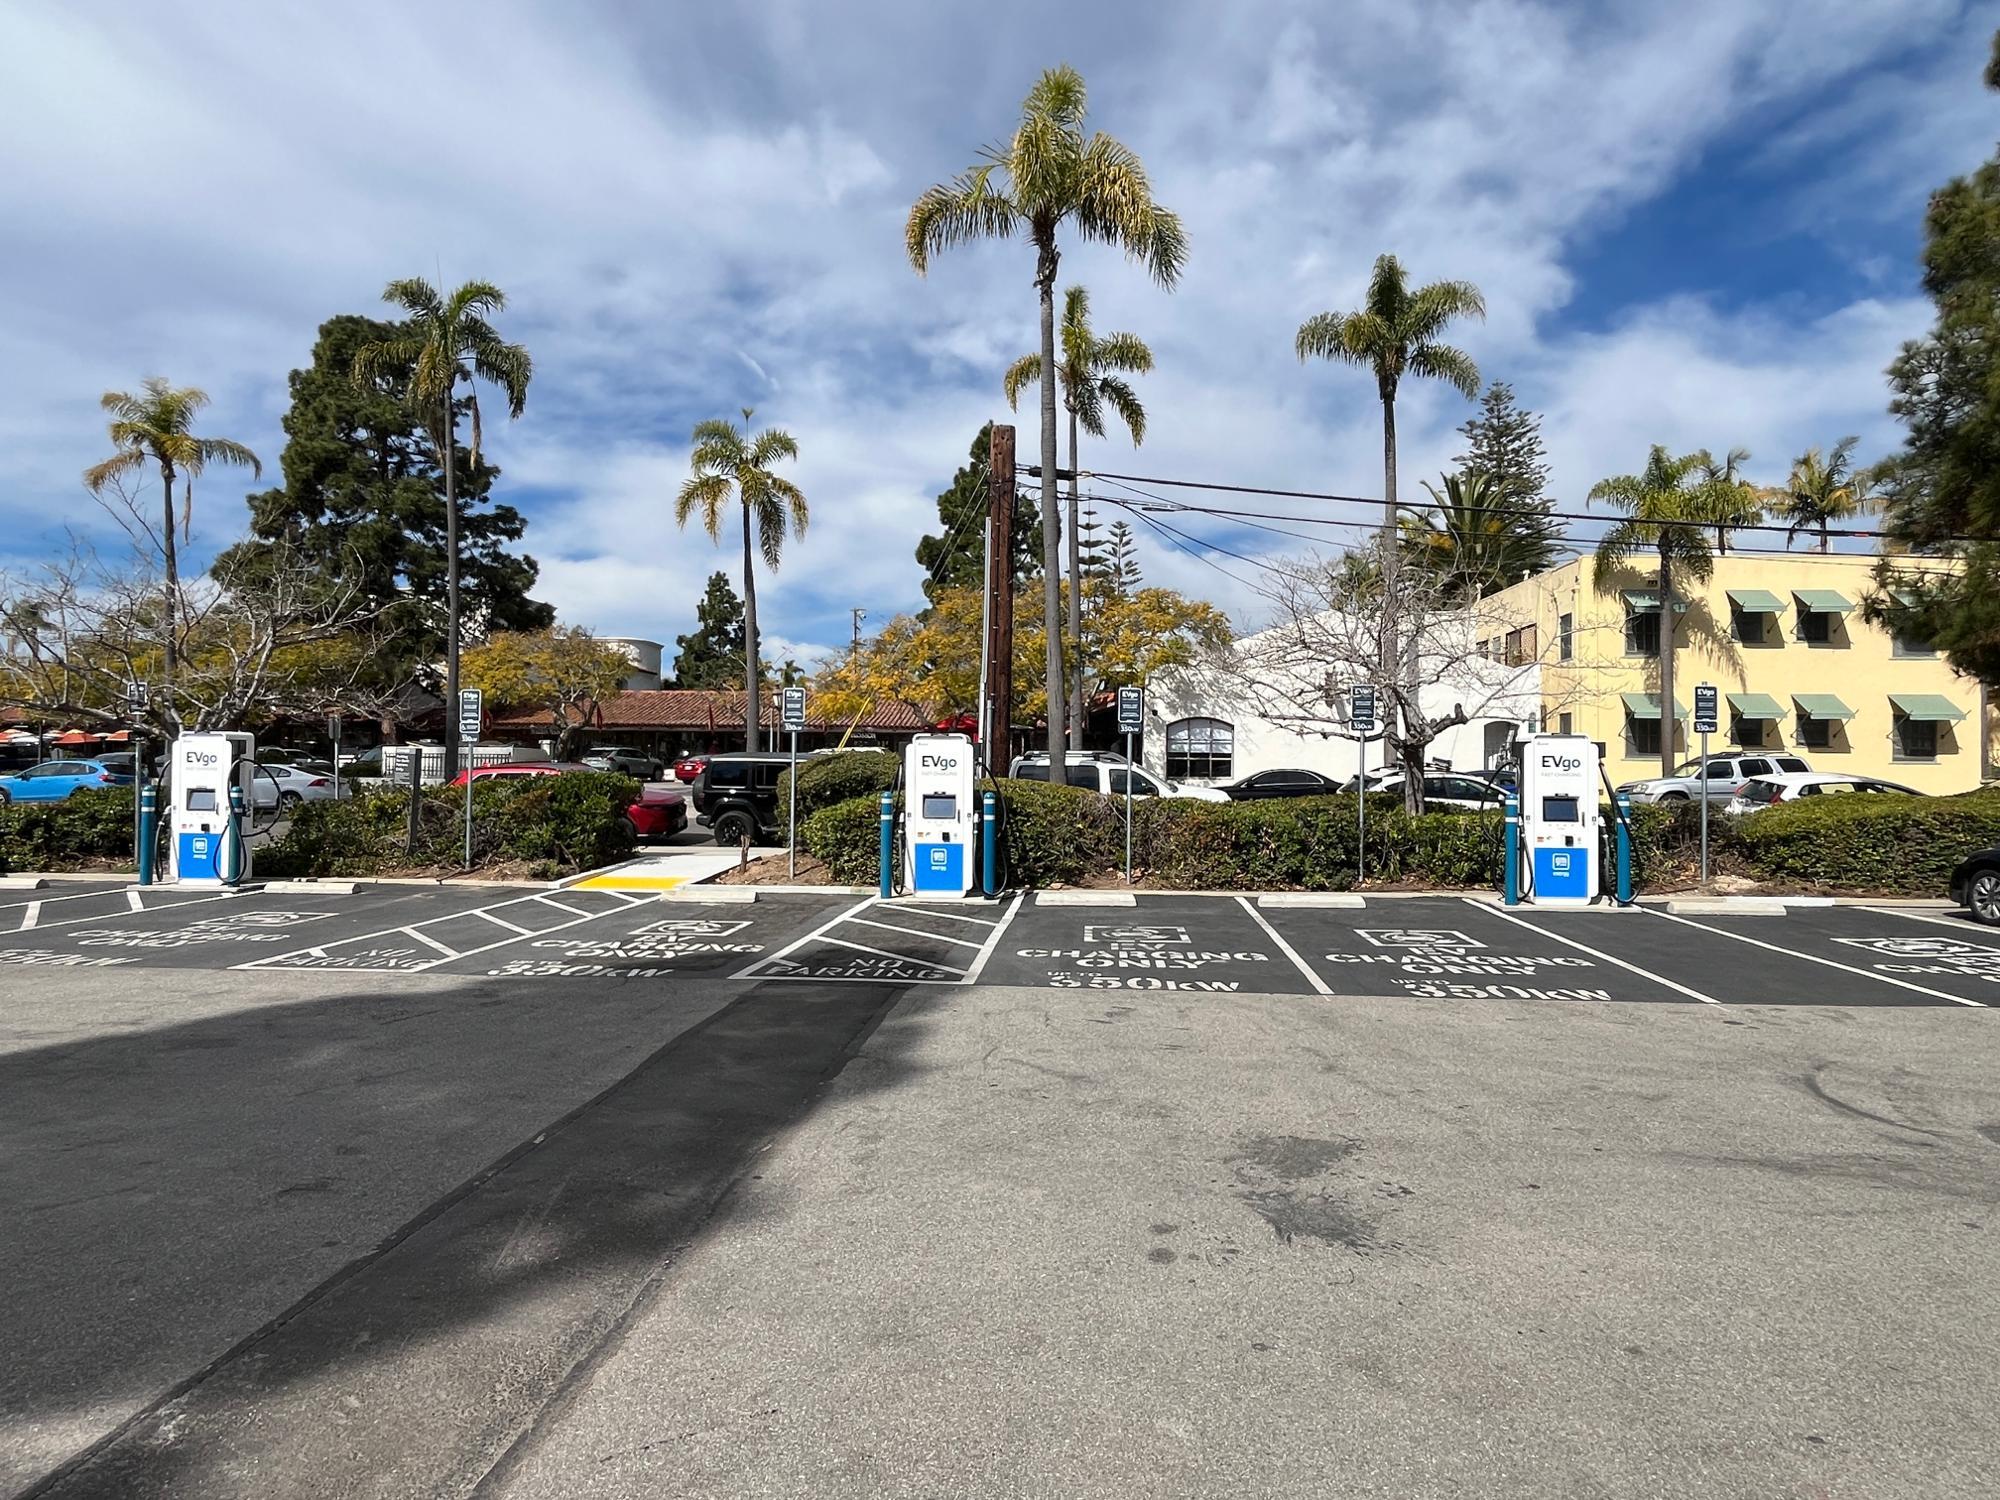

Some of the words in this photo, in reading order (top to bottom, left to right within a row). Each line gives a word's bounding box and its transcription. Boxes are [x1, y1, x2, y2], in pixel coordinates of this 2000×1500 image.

[463, 692, 478, 700] EVgo
[786, 690, 802, 698] EVgo
[1121, 690, 1139, 698] EVgo
[1697, 688, 1715, 696] EVgo
[186, 751, 218, 766] EVgo
[922, 755, 957, 770] EVgo
[1541, 755, 1581, 771] EVgo
[531, 939, 766, 952] CHARGING
[1110, 942, 1166, 951] EV
[1408, 947, 1466, 956] EV
[565, 948, 694, 958] ONLY
[1016, 948, 1269, 961] CHARGING
[848, 958, 904, 967] NO
[1075, 958, 1206, 969] ONLY
[1325, 953, 1596, 967] CHARGING
[487, 965, 674, 977] 350kW
[764, 966, 945, 979] PARKING
[1401, 963, 1537, 975] ONLY
[1049, 976, 1240, 992] 350kW
[1404, 983, 1611, 1001] 350kW
